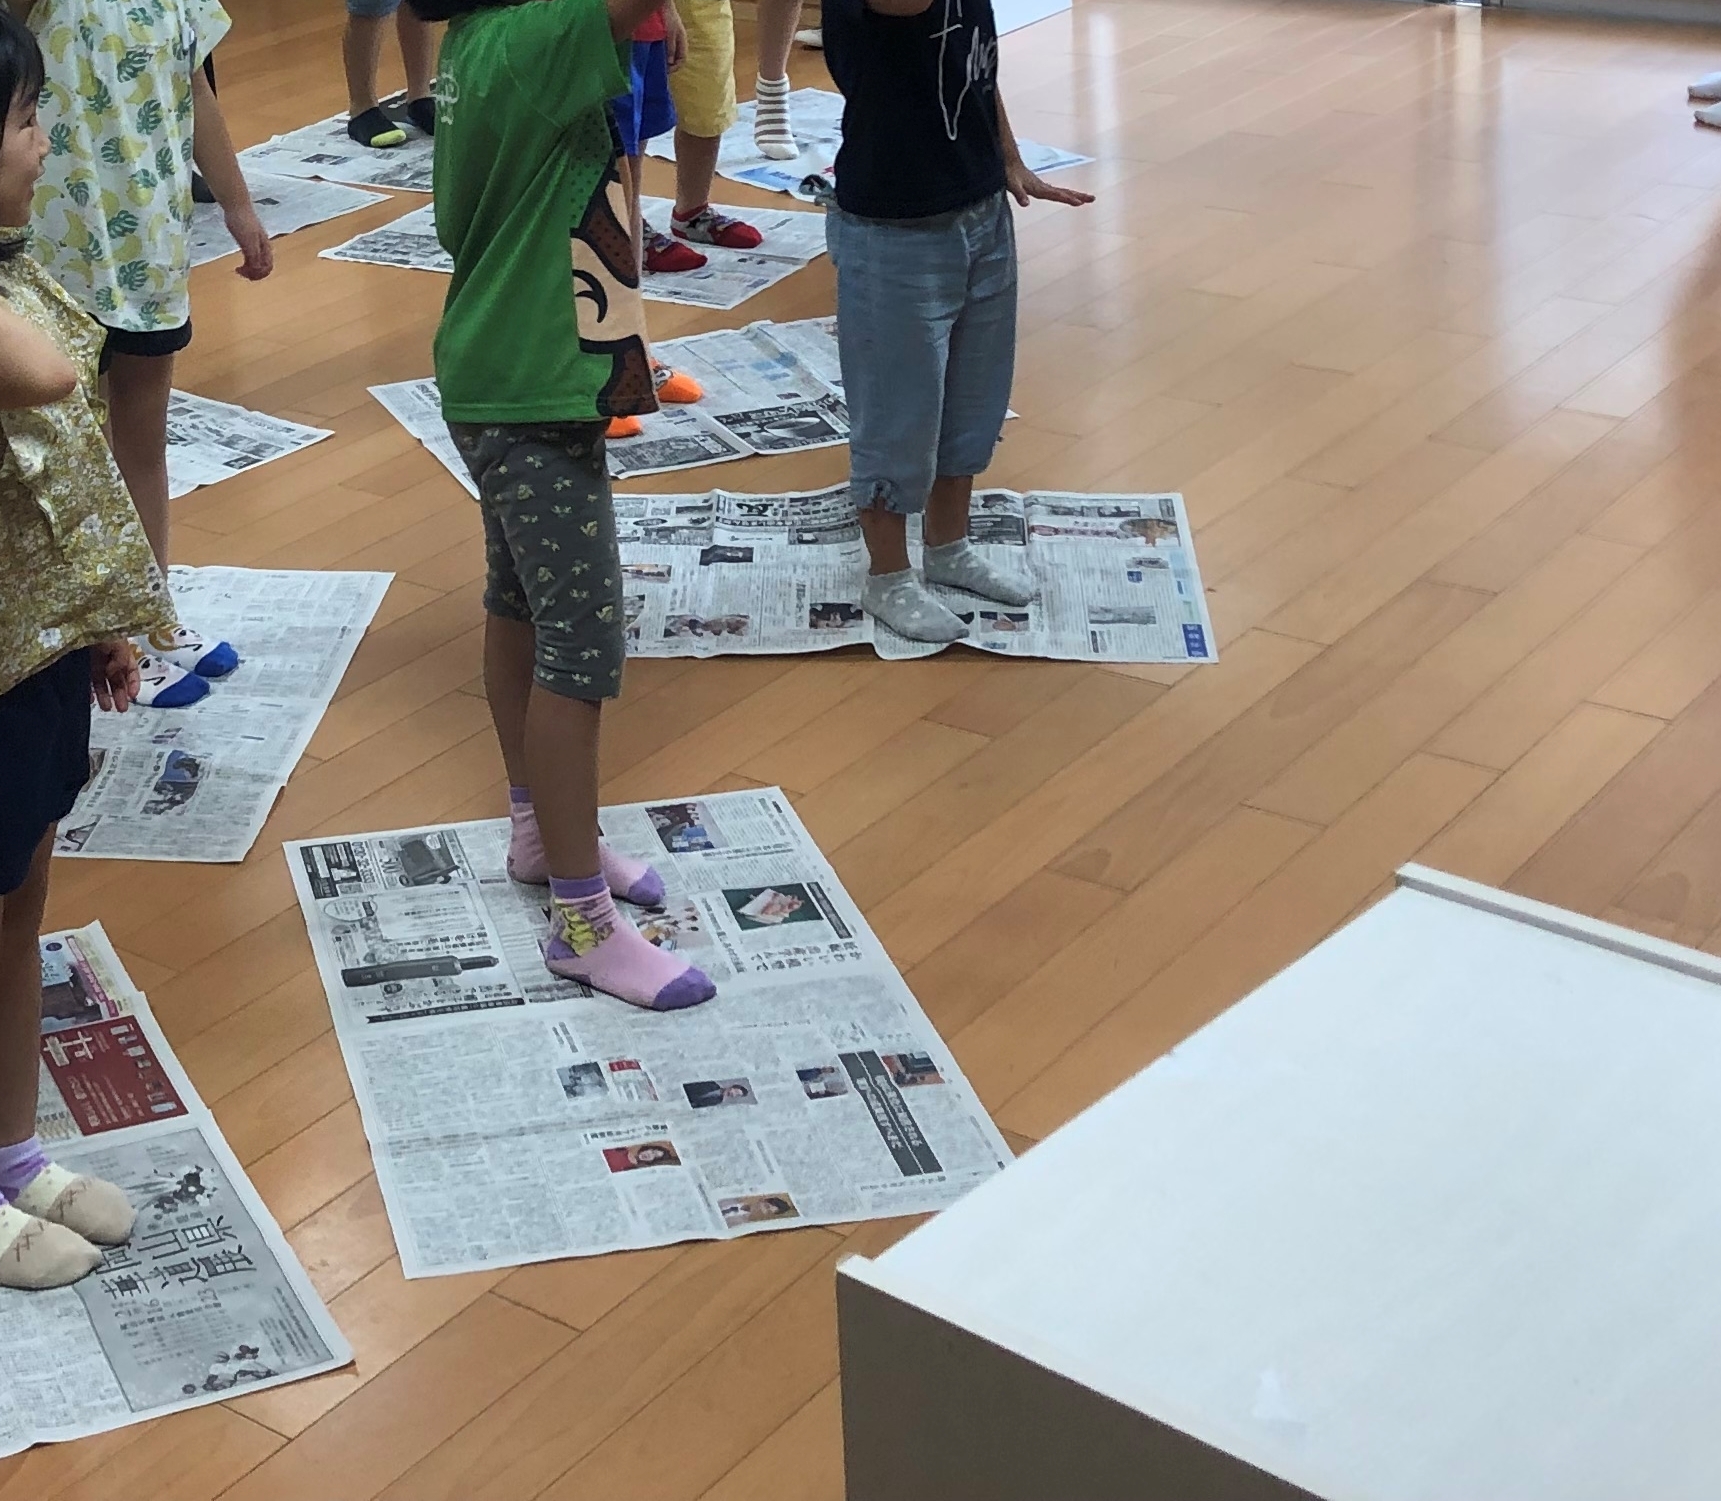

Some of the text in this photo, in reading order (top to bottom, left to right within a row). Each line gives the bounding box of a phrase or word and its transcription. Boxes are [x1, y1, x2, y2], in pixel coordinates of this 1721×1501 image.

[97, 1215, 240, 1268] 岡山県
[100, 1244, 256, 1301] 華道展
